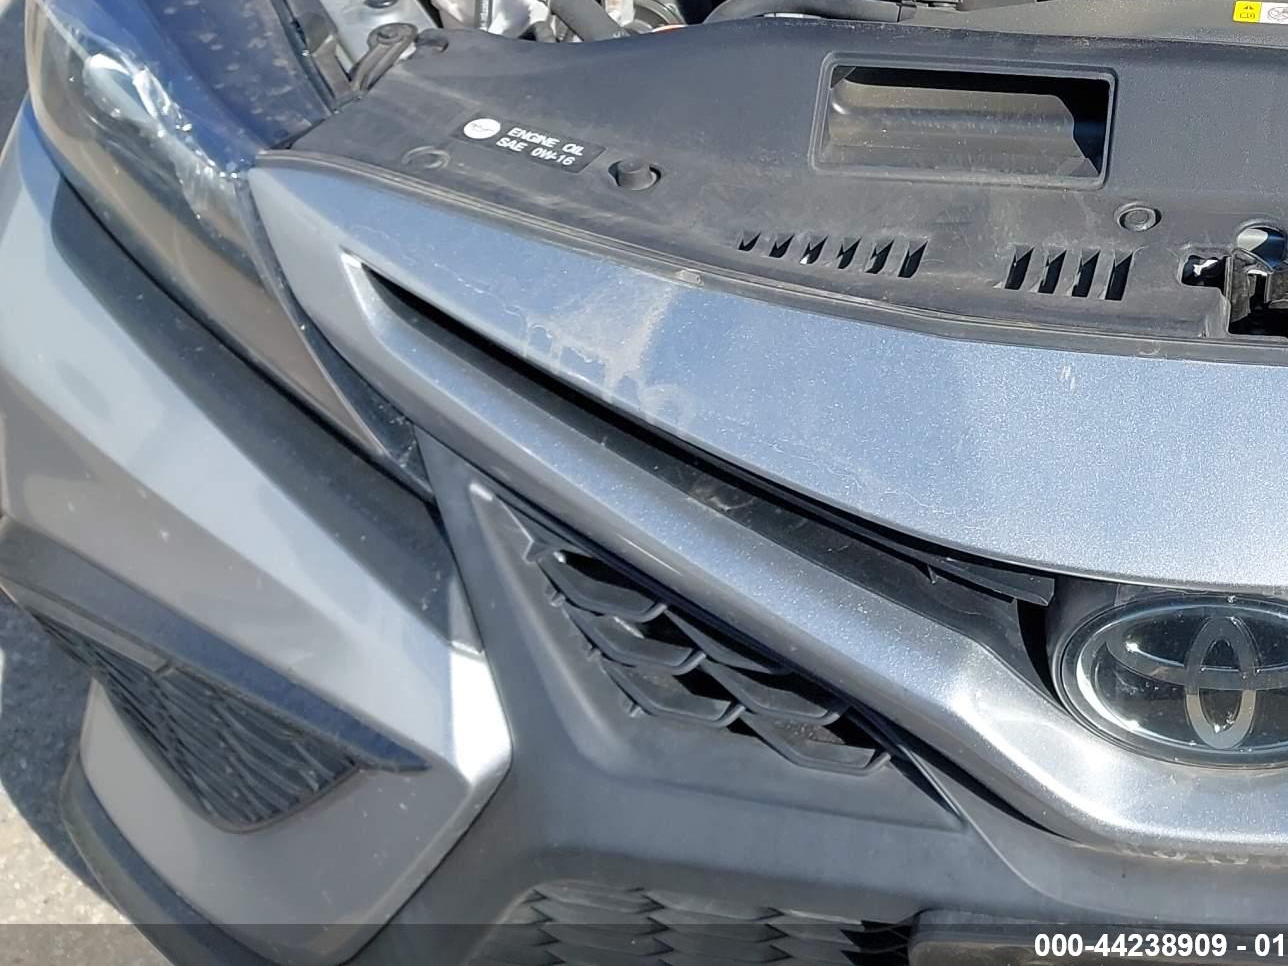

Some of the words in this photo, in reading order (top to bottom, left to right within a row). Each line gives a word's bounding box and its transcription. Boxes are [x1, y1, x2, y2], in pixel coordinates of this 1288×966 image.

[496, 137, 528, 153] SAE
[531, 147, 576, 166] 0W-16
[507, 127, 560, 148] ENGINE
[562, 143, 584, 157] OIL
